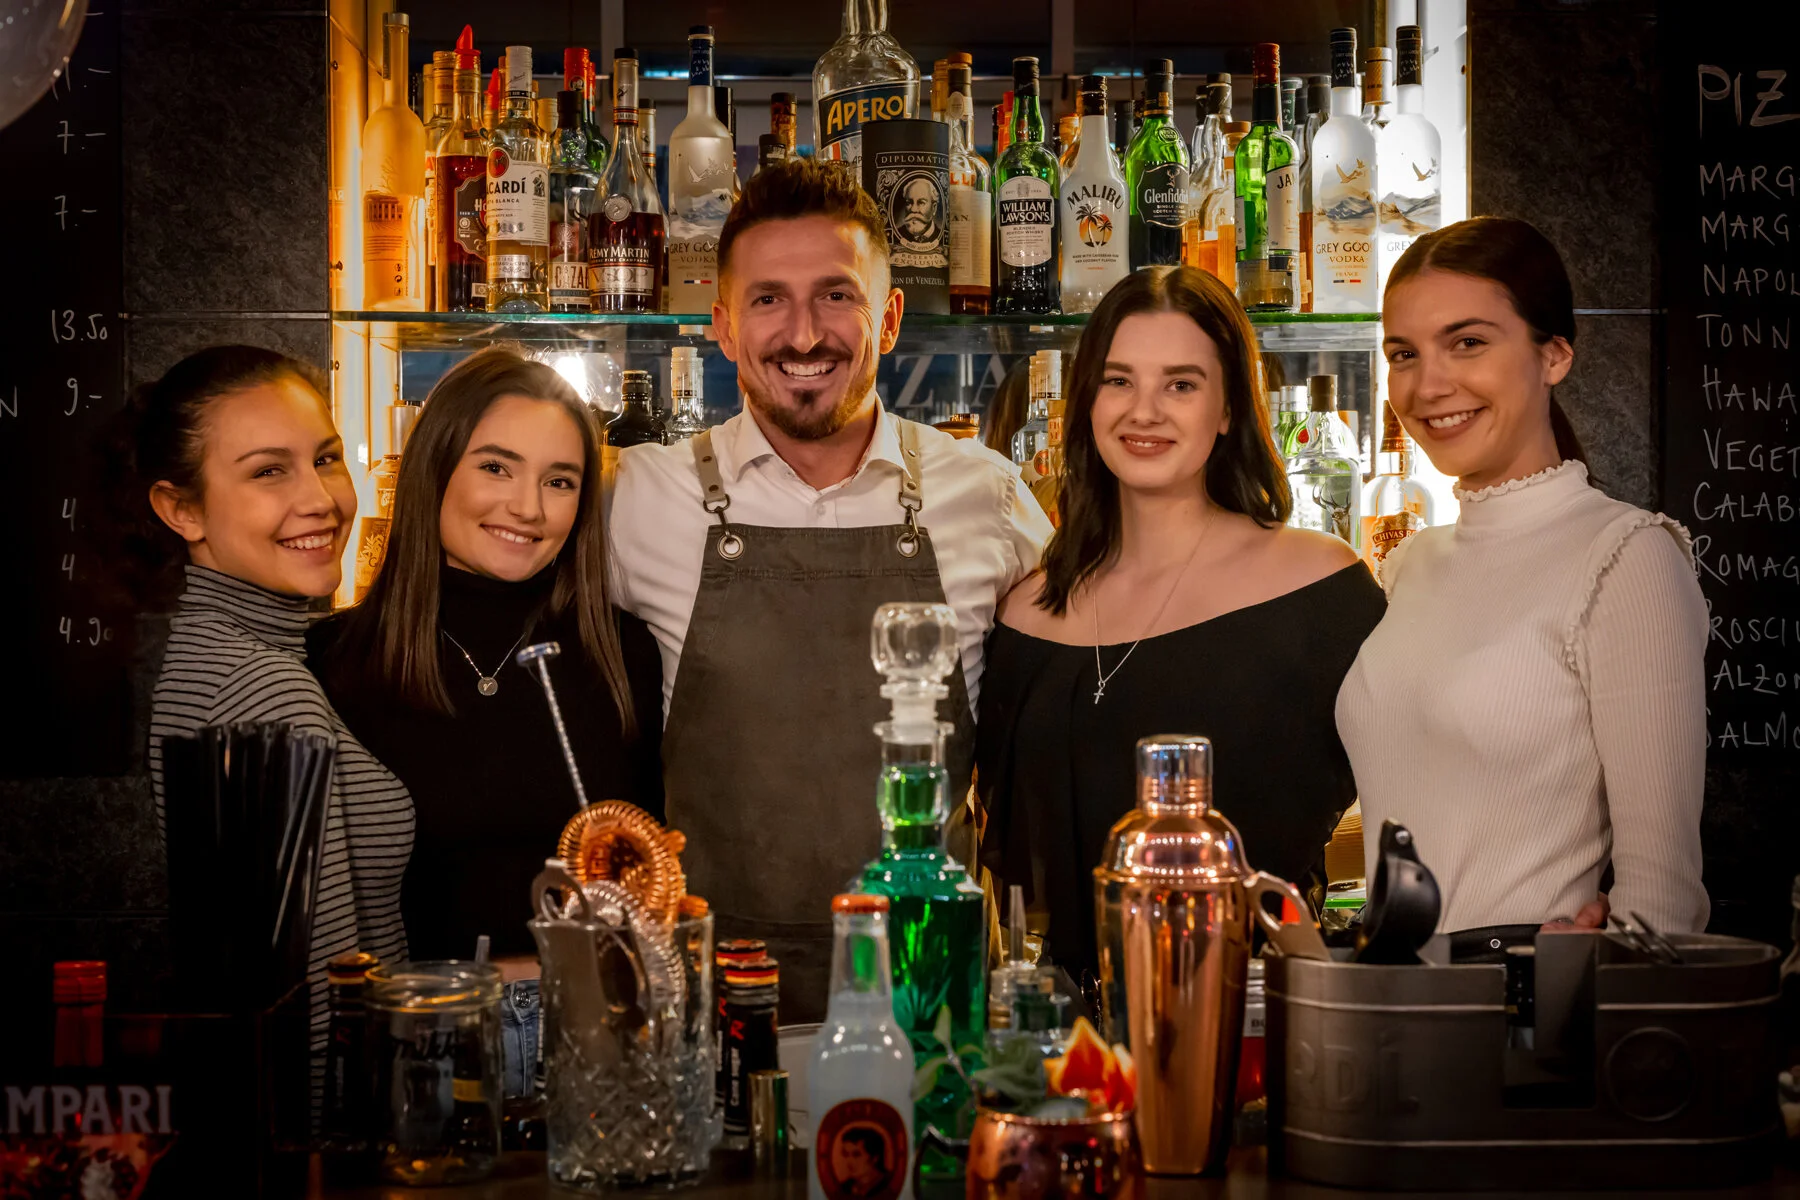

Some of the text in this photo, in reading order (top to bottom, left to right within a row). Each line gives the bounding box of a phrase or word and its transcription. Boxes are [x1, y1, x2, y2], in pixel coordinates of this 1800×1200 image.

[827, 95, 911, 135] APEROL
[1067, 184, 1124, 212] MALIBU
[1003, 202, 1046, 213] WILLIAM
[1001, 211, 1050, 224] LAWSON'S
[589, 246, 649, 260] RÉMY MARTIN
[670, 243, 690, 254] GREY
[1316, 242, 1339, 255] GREY
[894, 257, 944, 266] EXCLUSIVA
[1329, 255, 1365, 263] VODKA
[905, 276, 915, 285] DE
[1696, 313, 1791, 350] TONN
[1701, 364, 1798, 415] HAWA
[1703, 428, 1800, 480] VEGET
[1374, 530, 1403, 542] CHIVAS
[1712, 659, 1800, 695] ALZO
[0, 1084, 174, 1135] MPARI
